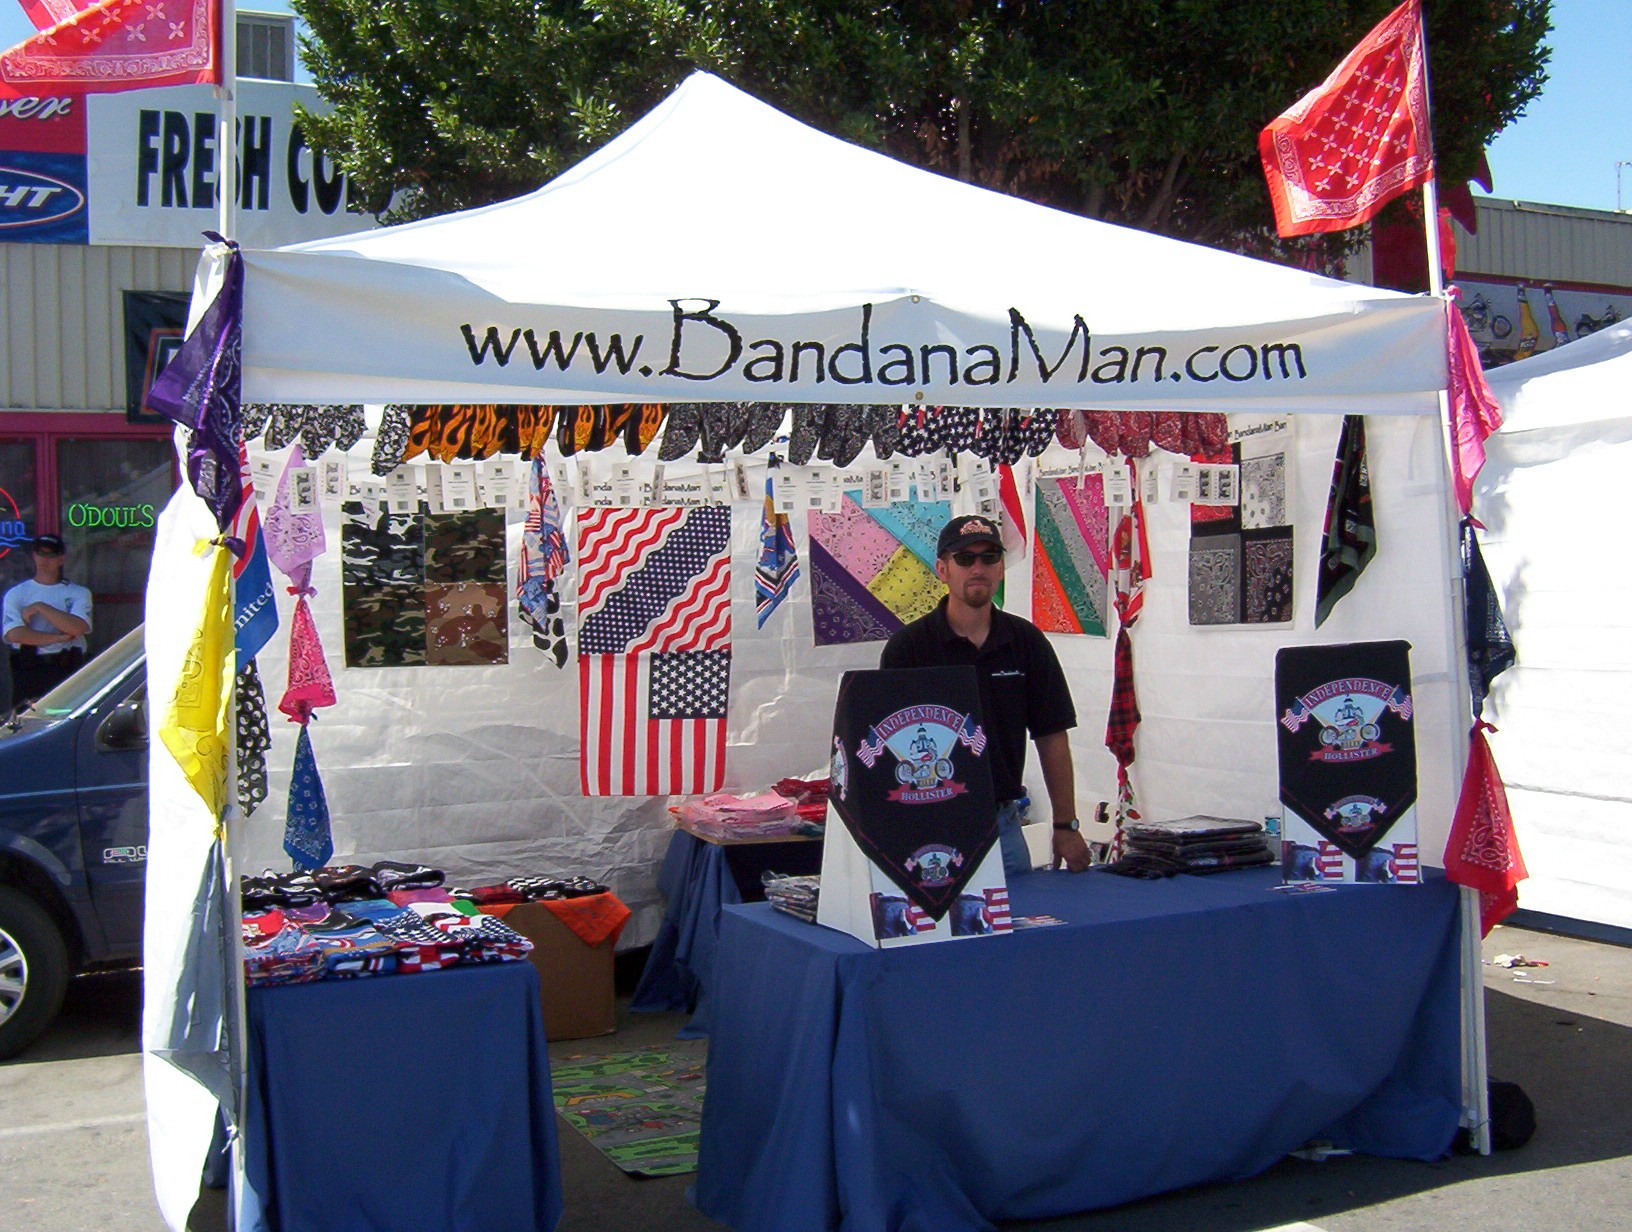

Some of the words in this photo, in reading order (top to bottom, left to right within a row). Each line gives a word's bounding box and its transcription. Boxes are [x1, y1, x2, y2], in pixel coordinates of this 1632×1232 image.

[459, 298, 1307, 385] www.BandanaMan.com
[1305, 680, 1391, 707] INDEPENDENCE
[878, 706, 962, 738] INDEPENDENCE
[1324, 747, 1377, 760] HOLLISTER
[901, 787, 954, 802] HOLLISTER
